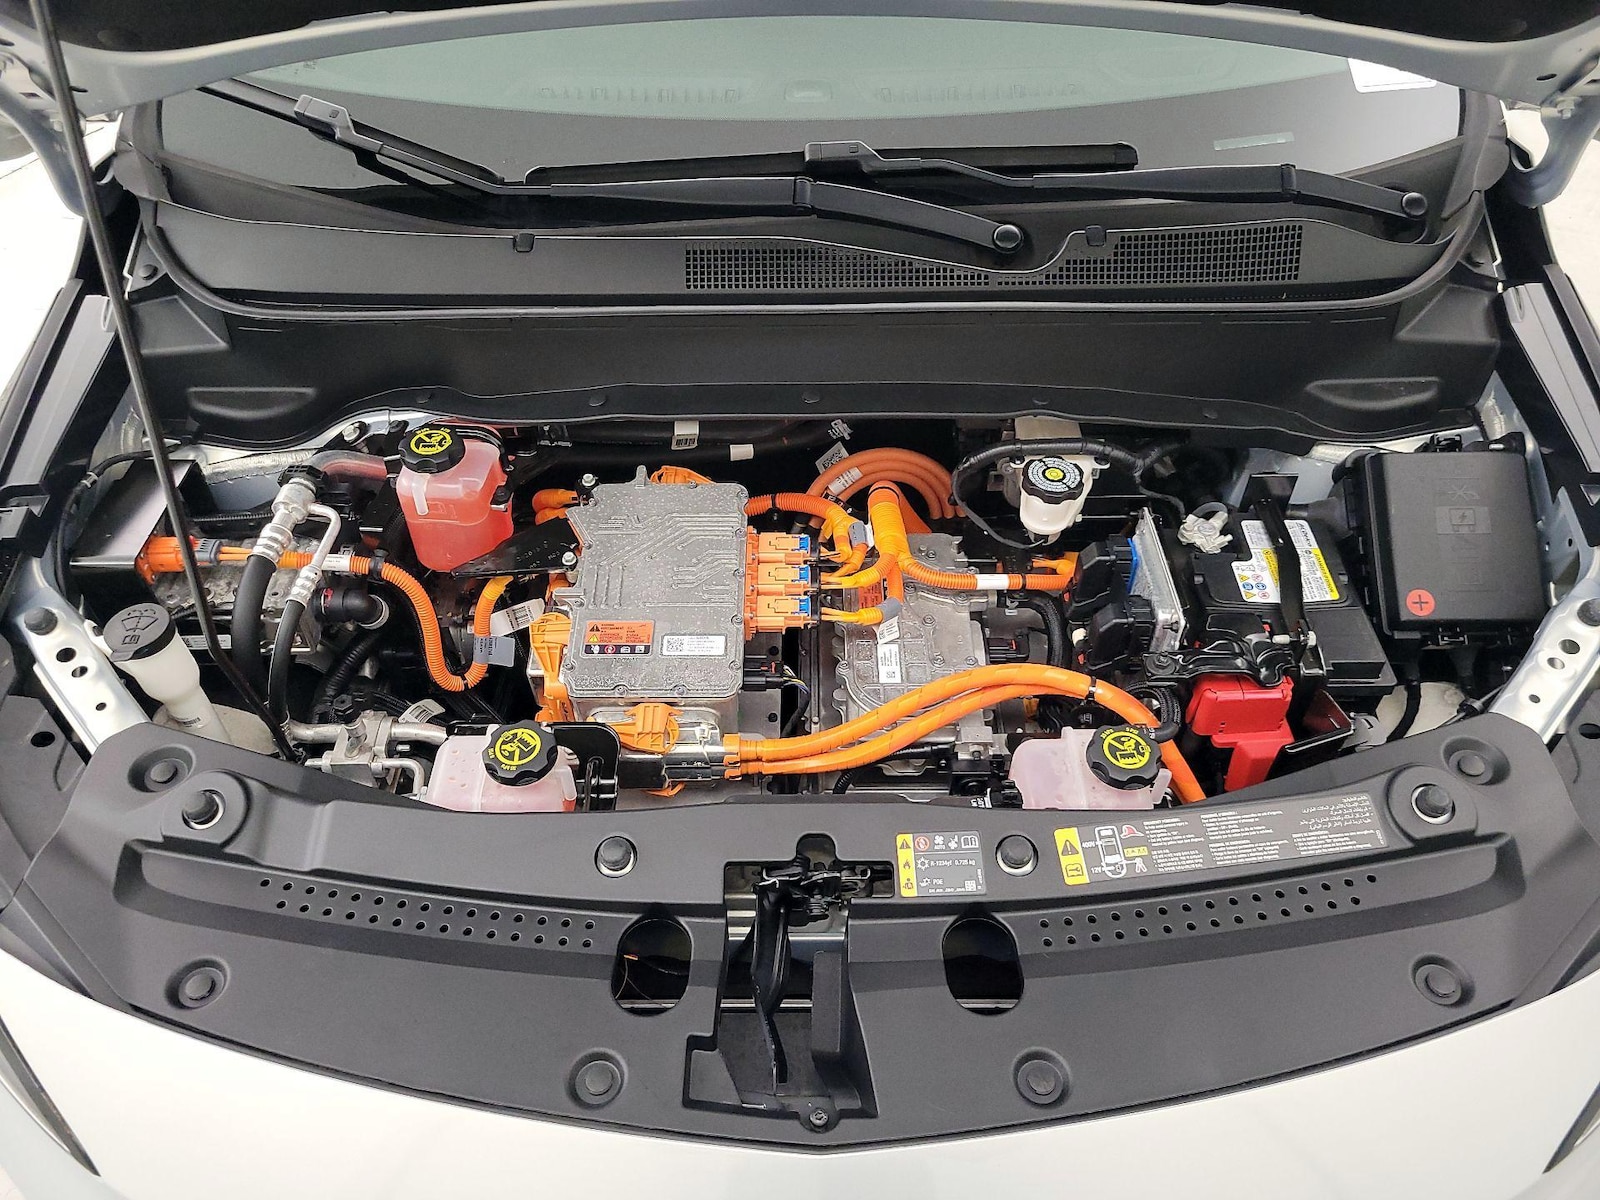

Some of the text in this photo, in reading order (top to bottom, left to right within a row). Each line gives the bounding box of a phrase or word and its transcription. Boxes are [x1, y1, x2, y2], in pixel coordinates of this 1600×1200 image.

[930, 859, 953, 868] R-1234yf
[968, 858, 976, 867] kg
[1091, 865, 1102, 874] 12V
